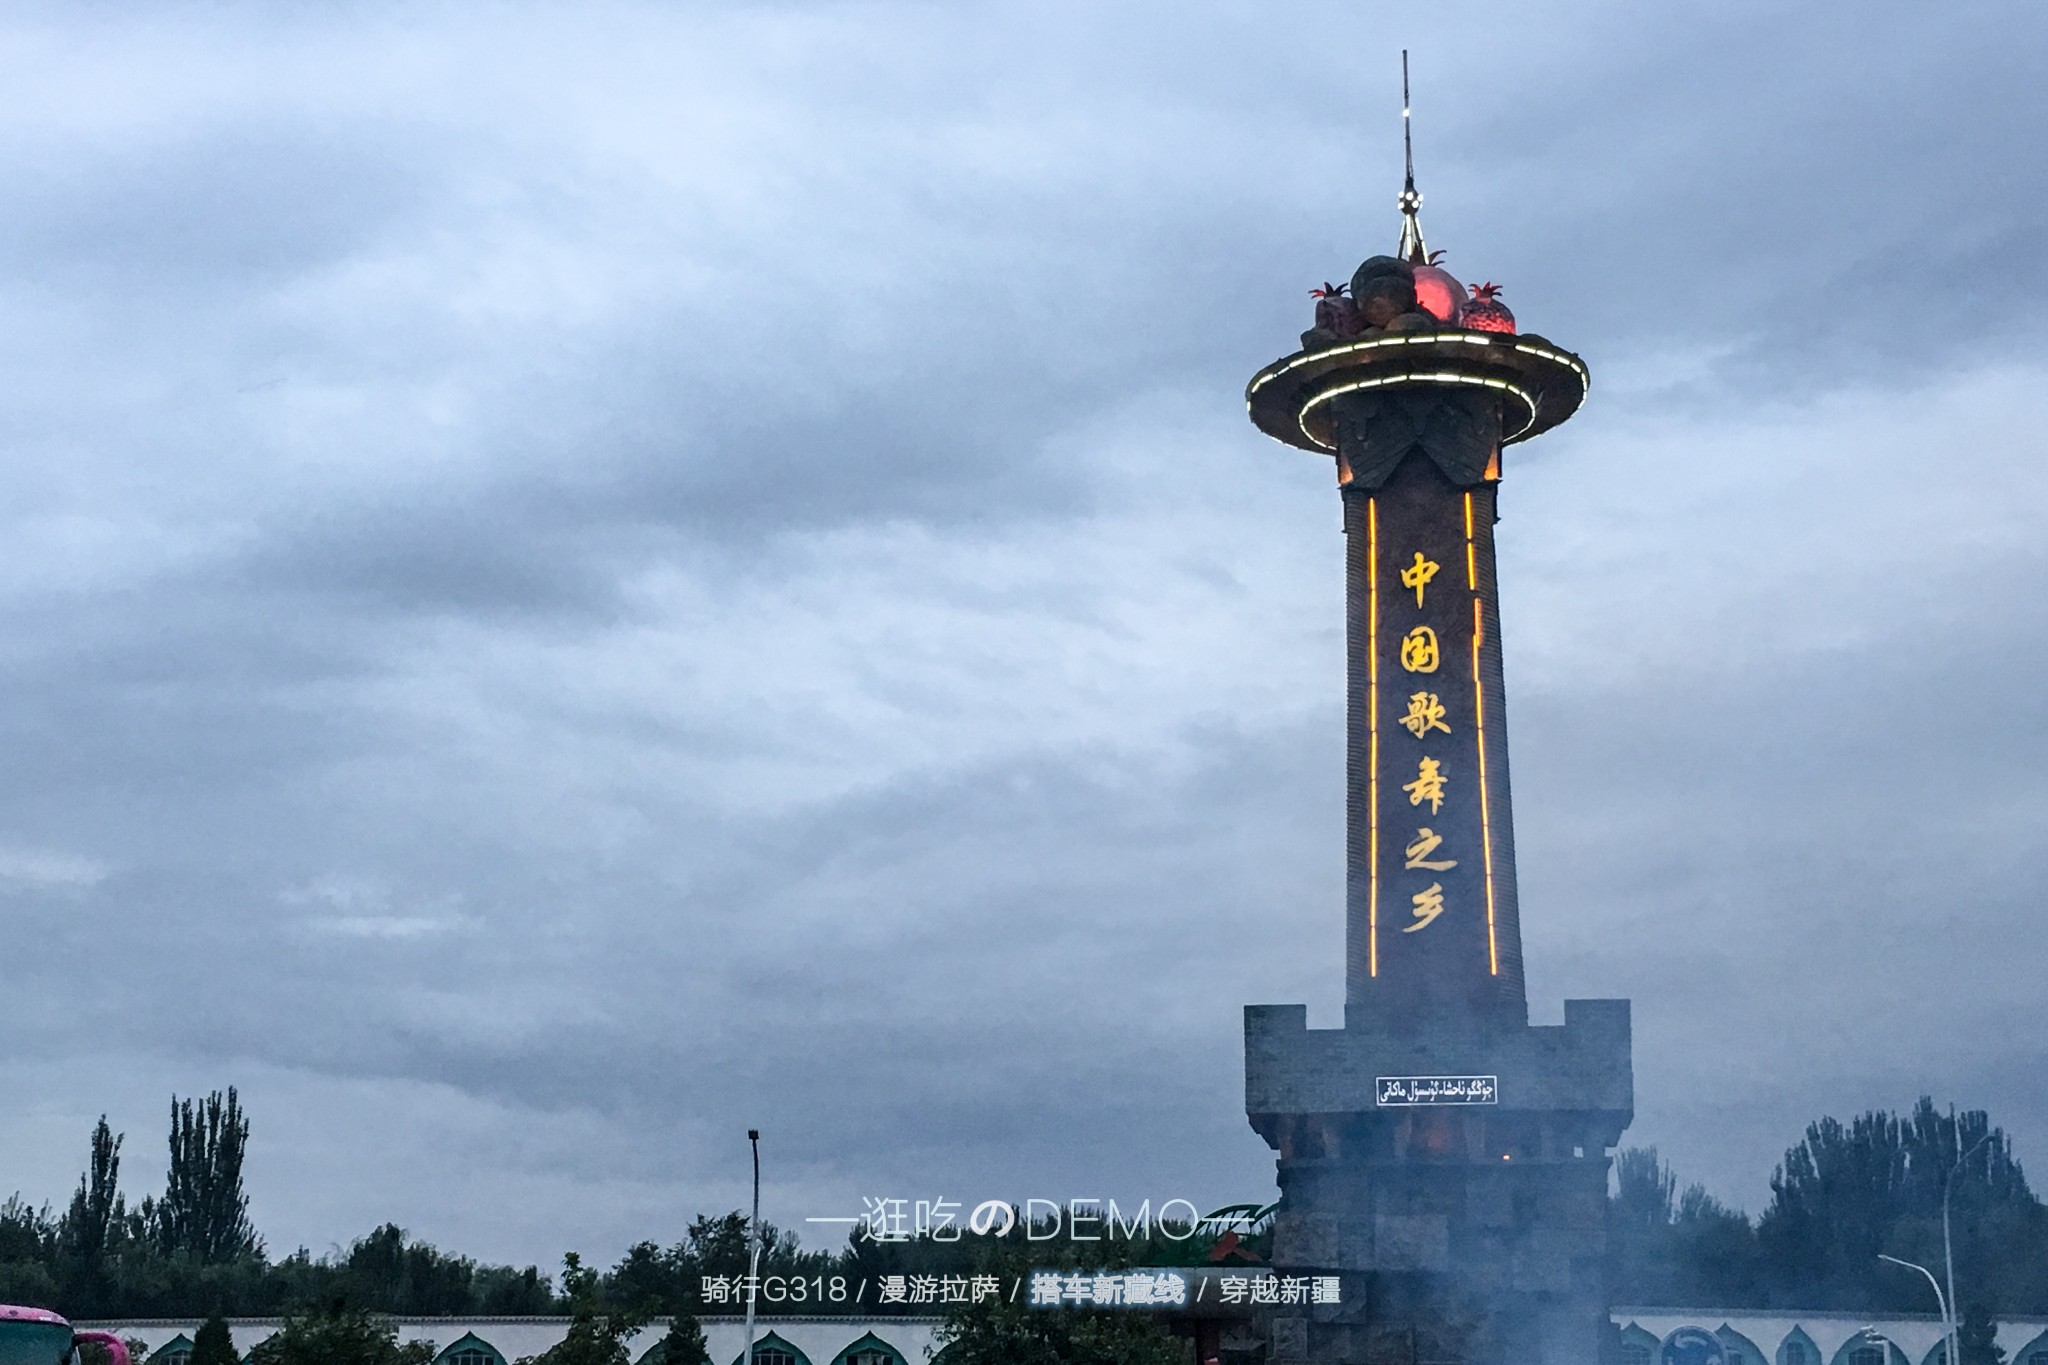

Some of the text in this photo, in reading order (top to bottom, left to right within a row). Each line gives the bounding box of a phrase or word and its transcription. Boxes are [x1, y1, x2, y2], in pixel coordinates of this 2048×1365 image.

[1399, 552, 1457, 933] 中国歌舞之乡
